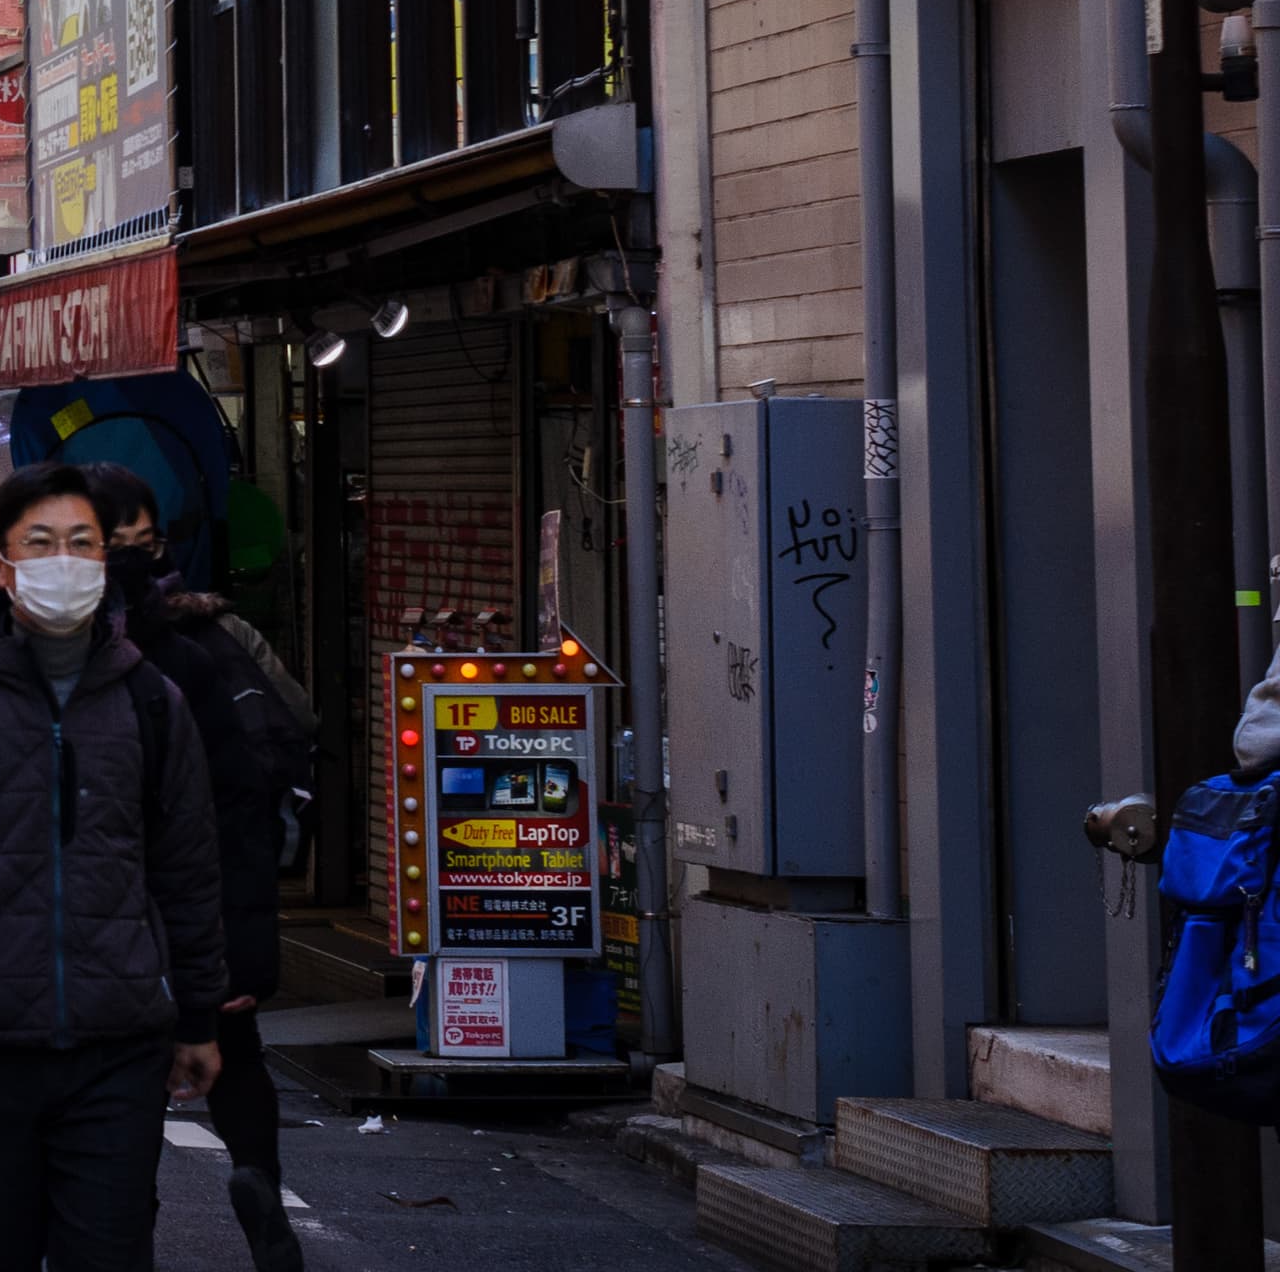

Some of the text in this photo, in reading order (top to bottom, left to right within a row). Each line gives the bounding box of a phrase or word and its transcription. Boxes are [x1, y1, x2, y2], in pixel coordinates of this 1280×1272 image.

[447, 703, 578, 726] 1F BIG SALE
[485, 734, 547, 754] Tokyo
[550, 737, 573, 751] PC
[463, 824, 580, 846] Duty Free LapTop
[446, 850, 583, 872] Smartphone Tablet
[449, 872, 582, 887] www.tokyopc.jp
[446, 896, 481, 912] INE
[551, 906, 586, 927] 3F
